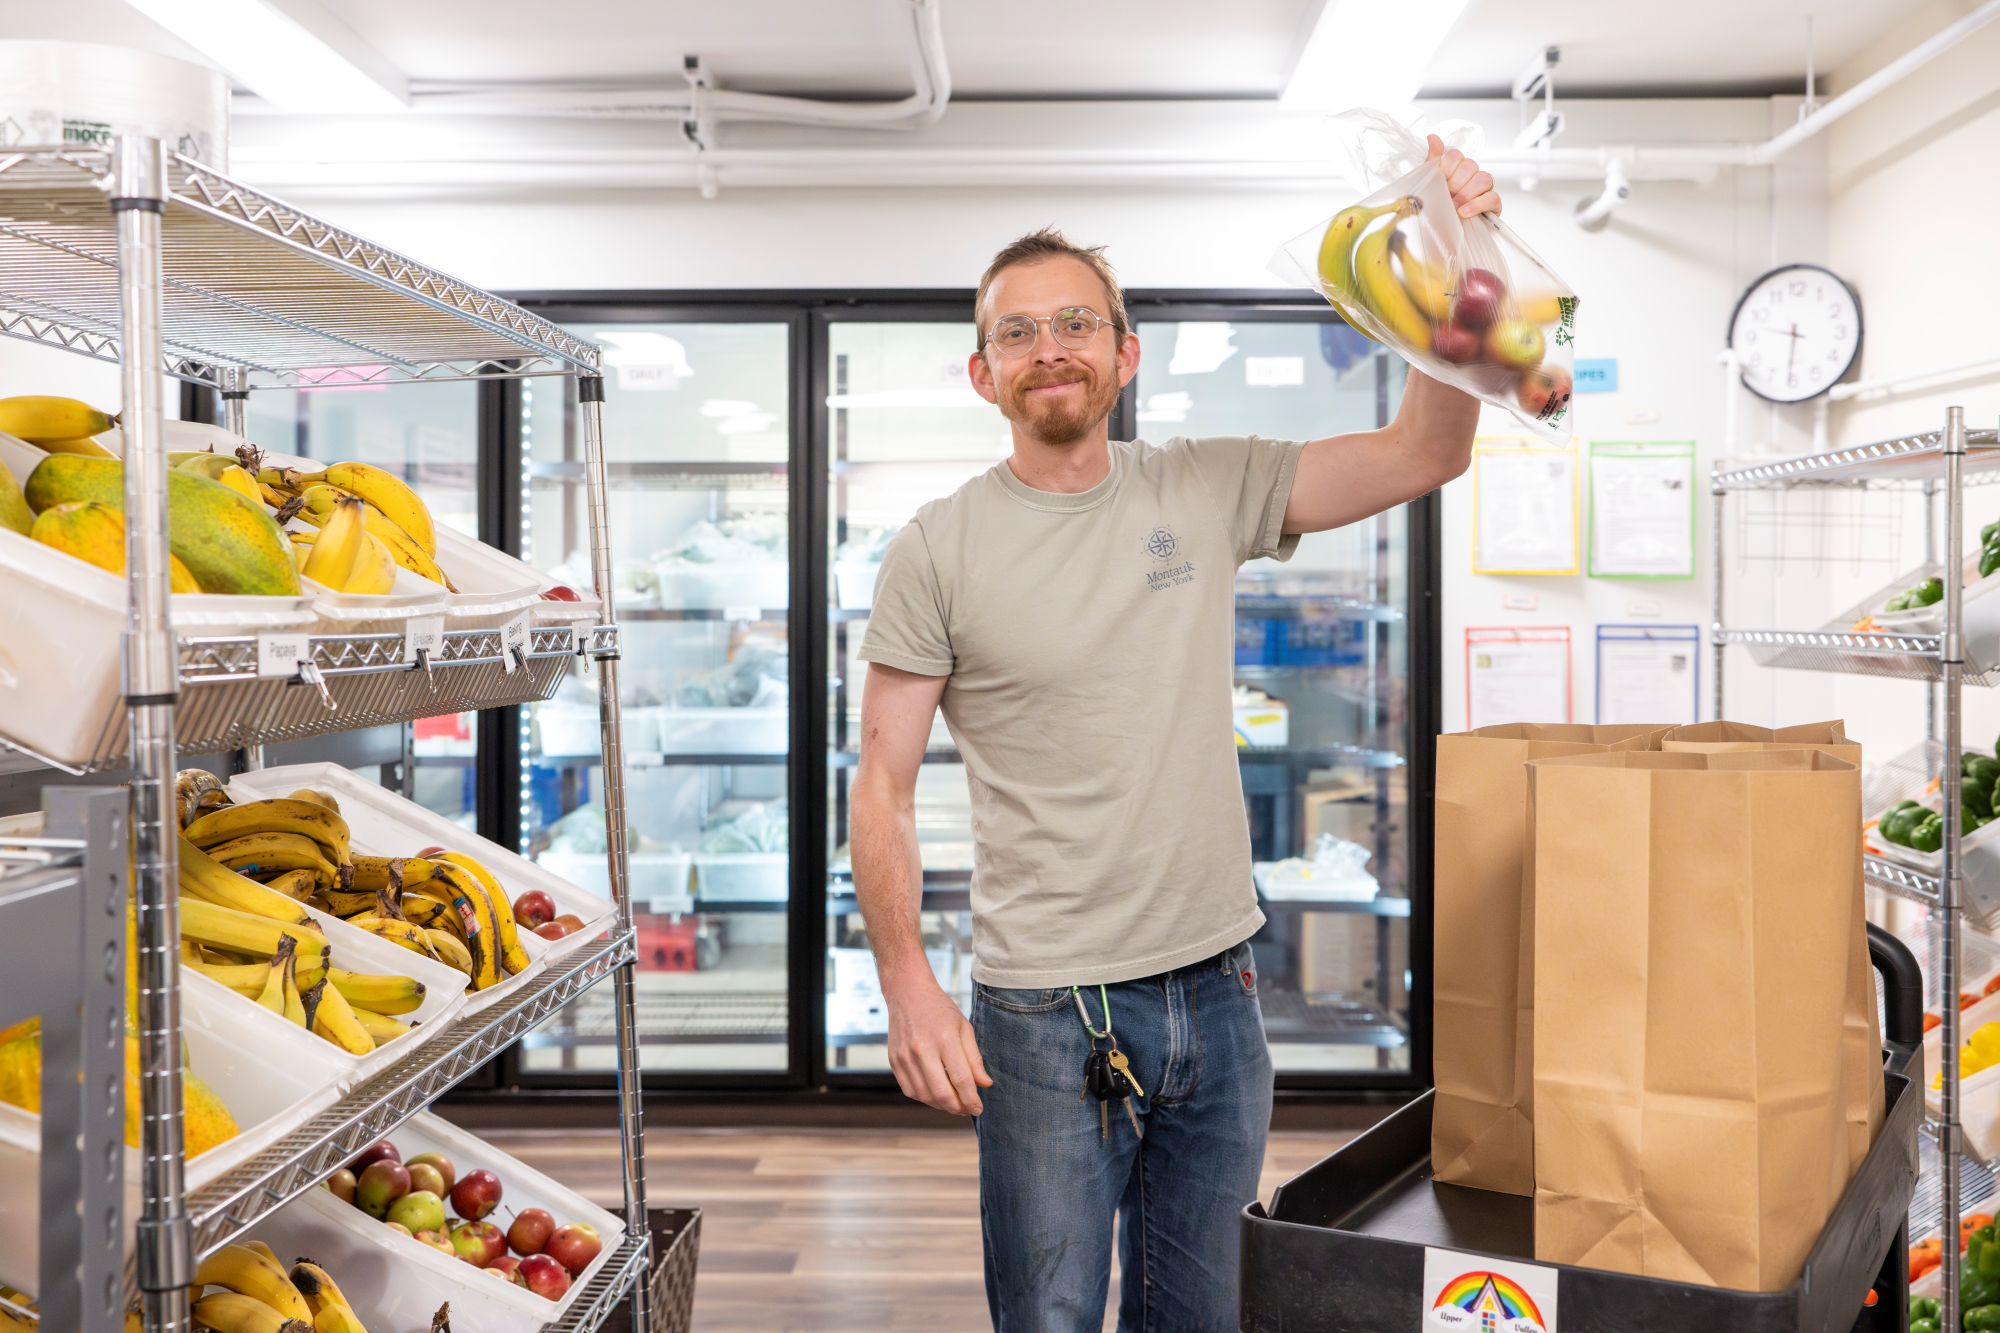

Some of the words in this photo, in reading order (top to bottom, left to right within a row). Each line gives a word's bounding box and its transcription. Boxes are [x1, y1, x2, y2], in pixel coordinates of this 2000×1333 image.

[1770, 289, 1783, 303] 11
[1788, 280, 1807, 297] 12
[1816, 286, 1824, 302] 1
[1751, 307, 1769, 322] 10
[1829, 301, 1841, 319] 2
[1745, 329, 1757, 345] 9
[1833, 324, 1846, 341] 3
[1826, 348, 1839, 361] 4
[1575, 368, 1607, 381] IPES
[1809, 365, 1821, 381] 5
[1146, 561, 1196, 585] Montauk
[1150, 581, 1171, 592] New
[1172, 573, 1194, 586] York
[269, 642, 297, 660] Papaya
[1440, 1311, 1463, 1323] Upper
